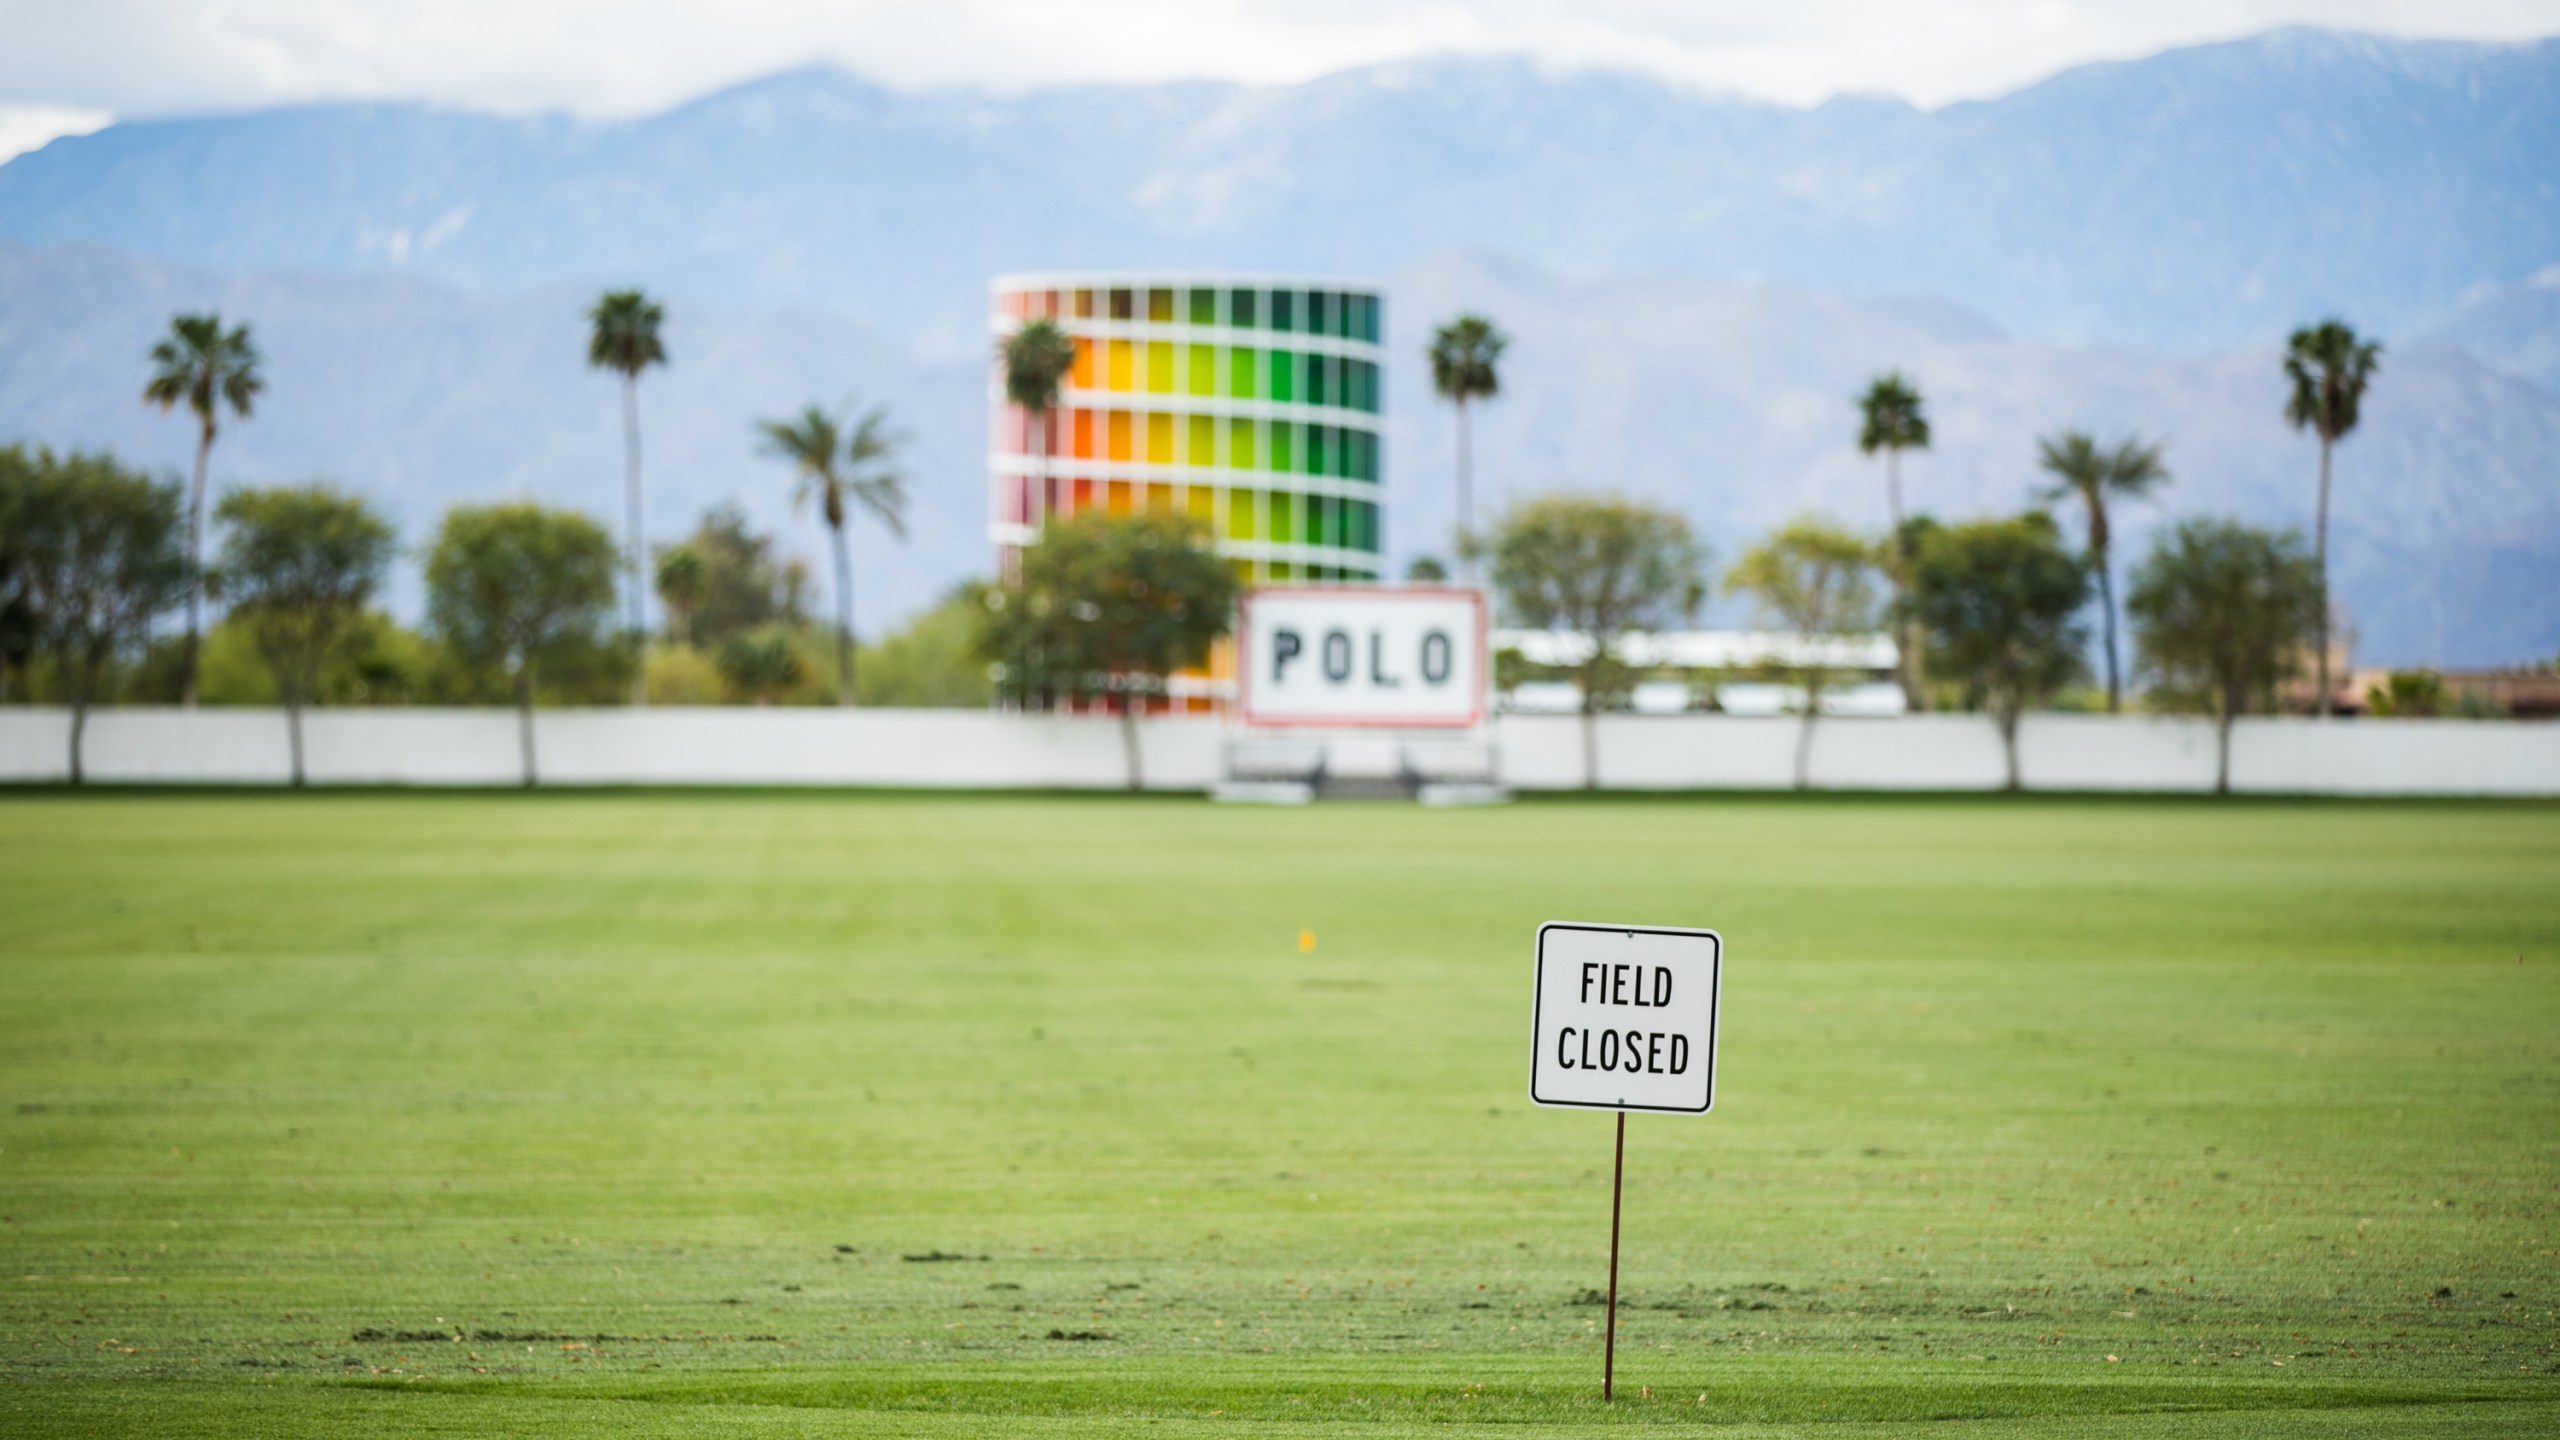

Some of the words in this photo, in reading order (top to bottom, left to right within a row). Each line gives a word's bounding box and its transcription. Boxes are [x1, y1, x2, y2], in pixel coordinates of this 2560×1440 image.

[1271, 626, 1454, 687] POLO
[1580, 962, 1674, 1008] FIELD
[1557, 1026, 1689, 1075] CLOSED
